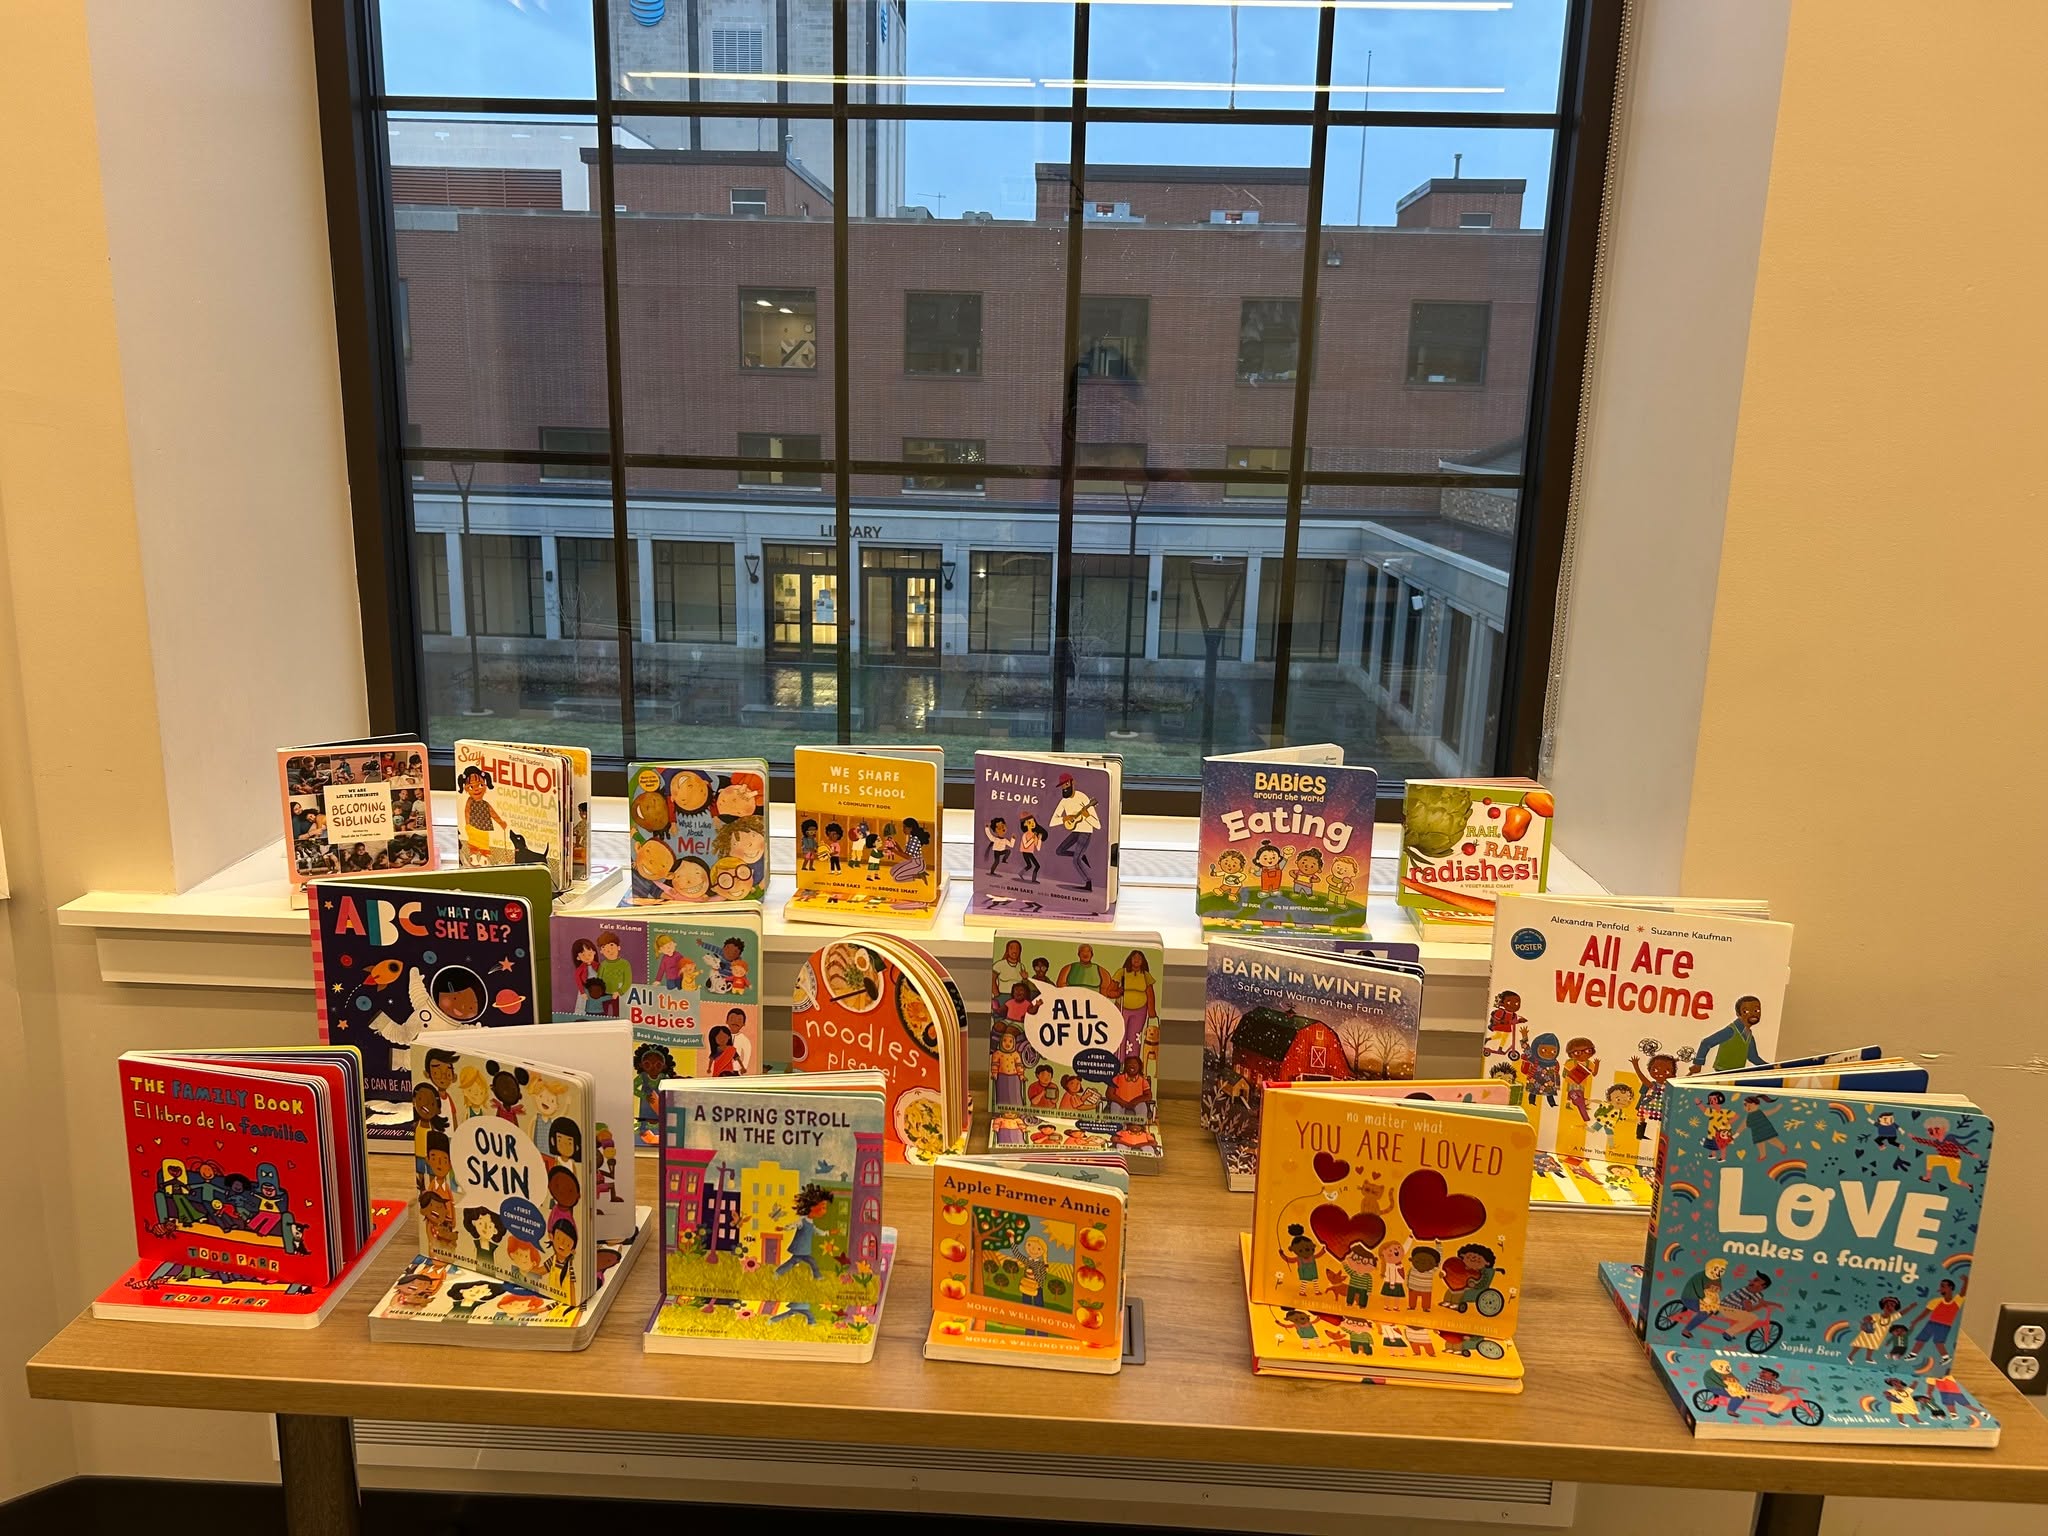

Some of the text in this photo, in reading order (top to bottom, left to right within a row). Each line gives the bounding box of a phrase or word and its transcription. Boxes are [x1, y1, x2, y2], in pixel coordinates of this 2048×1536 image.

[820, 524, 882, 539] LIARY
[458, 746, 482, 766] Say
[481, 755, 557, 795] HELLO!
[829, 765, 900, 782] WE SHARE
[985, 768, 1046, 789] FAMILIES
[497, 786, 558, 811] CIAO HOLA
[822, 782, 906, 800] THIS SCHOOL
[991, 789, 1039, 805] BELONG
[1253, 792, 1283, 801] around
[1284, 793, 1299, 802] the
[331, 801, 386, 816] BECOMING
[843, 801, 875, 809] COMMUNITY
[333, 814, 387, 827] SIBLINGS
[510, 820, 538, 832] SHALOM
[678, 819, 693, 829] What
[698, 821, 712, 829] Like
[1220, 804, 1353, 854] Eating
[687, 829, 704, 837] About
[1466, 825, 1501, 838] RAH,
[677, 836, 711, 855] Me!
[1484, 840, 1532, 862] RAH,
[1409, 857, 1539, 883] radishes!
[334, 895, 429, 946] ABC
[436, 905, 499, 921] WHAT CAN
[434, 919, 512, 943] SHE BE?
[1550, 915, 1732, 942] Alexandra Penfold Suzanne Kaufman
[1514, 943, 1543, 951] POSTER
[1579, 934, 1694, 979] All Are
[1222, 957, 1402, 1005] BARN IN WINTER
[627, 987, 690, 1011] All the
[1237, 982, 1384, 1015] Safe and Warm on the Farm
[1555, 969, 1714, 1020] Welcome
[630, 1006, 696, 1029] Babies
[1052, 999, 1099, 1020] ALL
[652, 1034, 670, 1043] About
[672, 1036, 700, 1045] Adoption
[1039, 1021, 1109, 1047] OF US
[805, 1019, 928, 1078] noodles,
[1076, 1060, 1115, 1068] CONVERSATION
[130, 1076, 304, 1115] THE FAMILY BOOK
[371, 1078, 387, 1090] CAN
[389, 1079, 399, 1092] BE
[133, 1100, 309, 1144] El libro de la familia
[694, 1105, 850, 1128] A SPRING STROLL
[1346, 1111, 1444, 1135] no matter what
[367, 1128, 405, 1137] NYTHING
[719, 1127, 824, 1147] IN THE CITY
[474, 1127, 518, 1163] OUR
[1296, 1119, 1504, 1177] YOU ARE LOVED
[1626, 1152, 1655, 1161] Bestseller
[466, 1155, 530, 1201] SKIN
[943, 1175, 1111, 1217] Apple Farmer Annie
[503, 1211, 541, 1228] CONVERSATION
[517, 1206, 531, 1216] FIRST
[1717, 1166, 1950, 1255] LOVE
[522, 1226, 535, 1236] RACE
[187, 1247, 280, 1273] TODD PARR
[1722, 1239, 1919, 1284] makes a family
[433, 1248, 453, 1258] MEGAN
[482, 1261, 504, 1274] JESSICA
[529, 1277, 549, 1291] ISABEL
[550, 1286, 567, 1298] ROXAS
[162, 1293, 270, 1307] TODD PARR
[388, 1309, 414, 1317] MEGAN
[966, 1301, 1077, 1331] MONICA WELLINGTON
[965, 1334, 1081, 1352] MONICA WELLINGTON
[1779, 1341, 1814, 1355] Sophie
[1816, 1343, 1842, 1358] Beer
[1828, 1413, 1891, 1425] Sophie Beer
